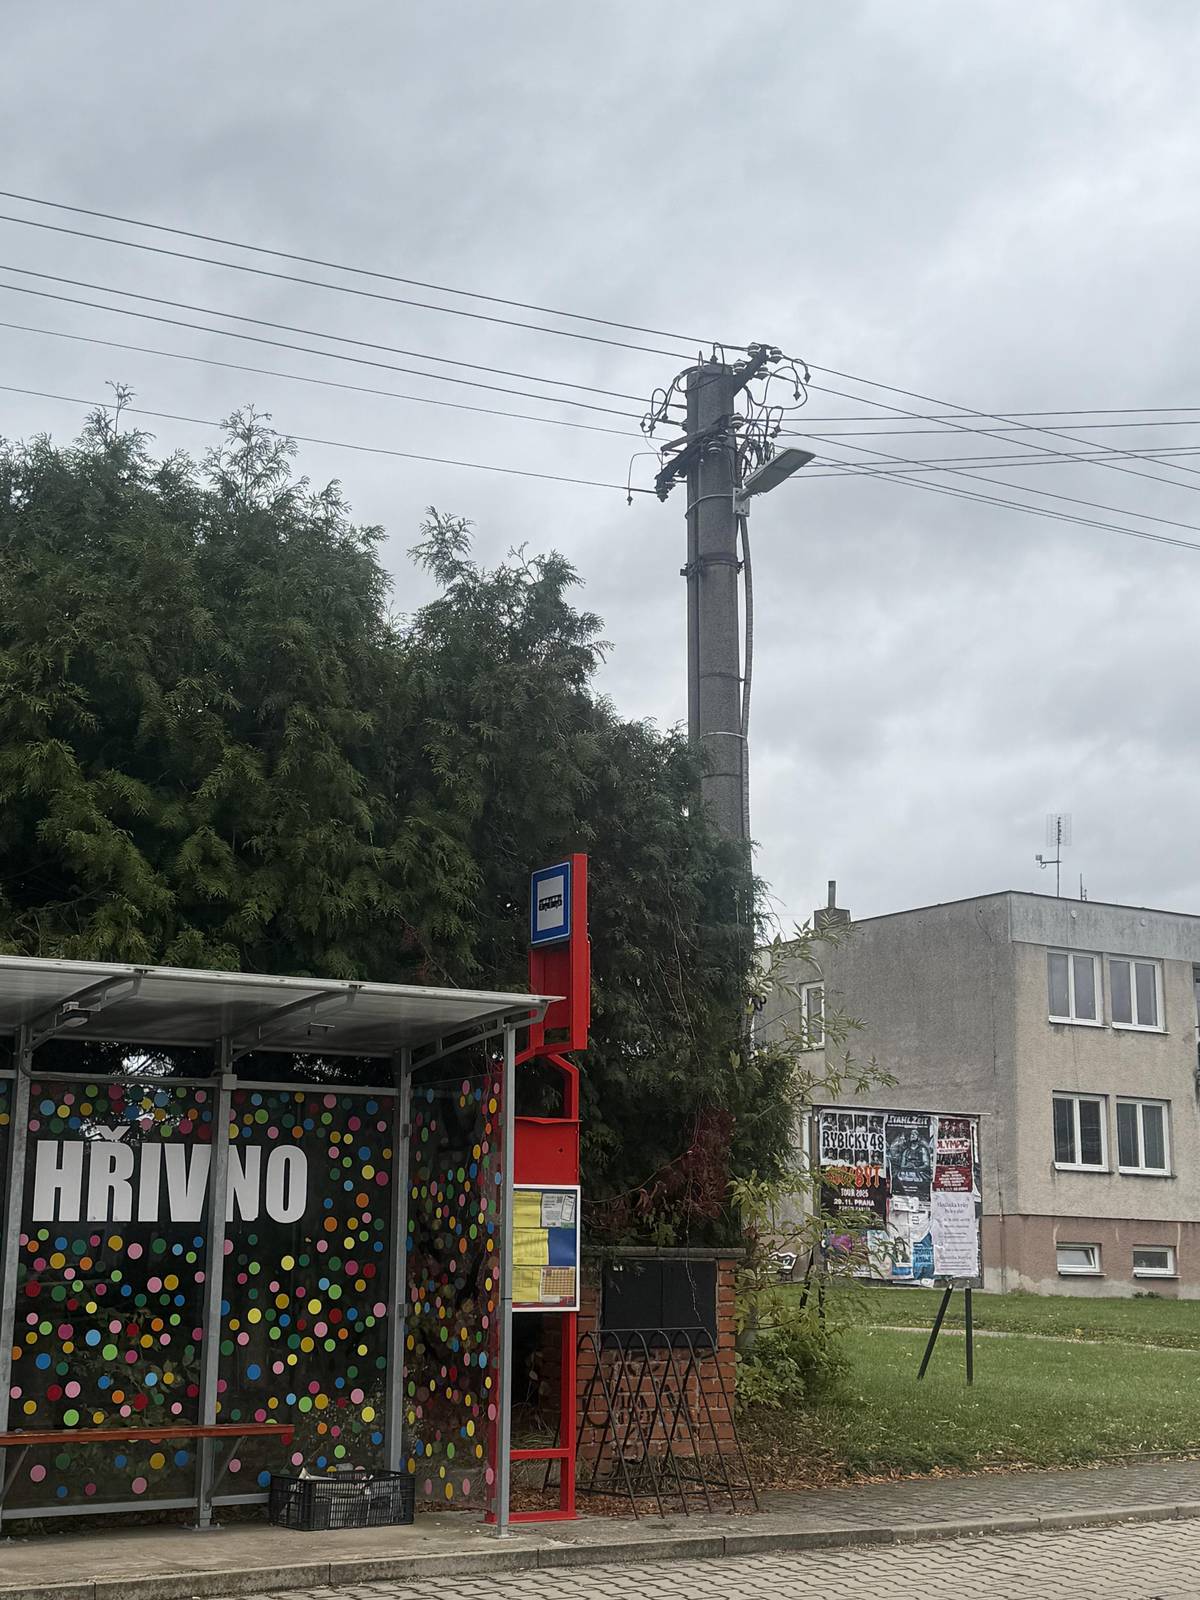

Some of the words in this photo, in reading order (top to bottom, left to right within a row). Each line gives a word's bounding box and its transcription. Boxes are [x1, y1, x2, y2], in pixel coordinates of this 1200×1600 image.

[870, 1133, 884, 1151] 48
[32, 1125, 308, 1224] HŘIVNO
[840, 1187, 855, 1197] TOUR
[855, 1189, 869, 1198] 2025
[854, 1199, 875, 1207] PRAHA
